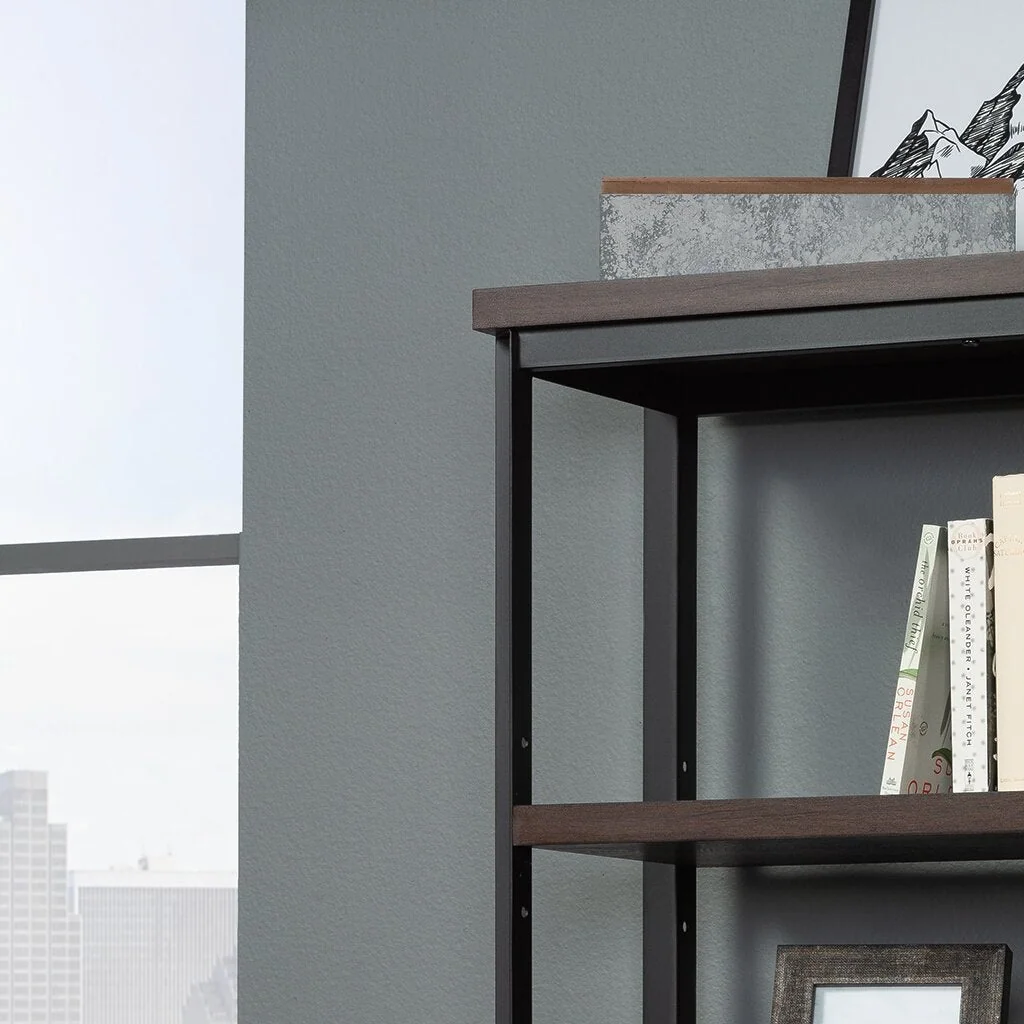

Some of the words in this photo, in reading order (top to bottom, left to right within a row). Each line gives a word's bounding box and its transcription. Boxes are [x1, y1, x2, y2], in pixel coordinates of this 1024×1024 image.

[919, 560, 930, 575] the
[964, 566, 972, 600] WHITE
[913, 578, 926, 619] orchid
[904, 622, 922, 655] thief
[964, 605, 972, 663] OLEANDER
[965, 676, 973, 709] JANET
[887, 687, 906, 761] ORLEAN
[899, 687, 914, 741] SUSAN
[965, 714, 973, 746] FITCH
